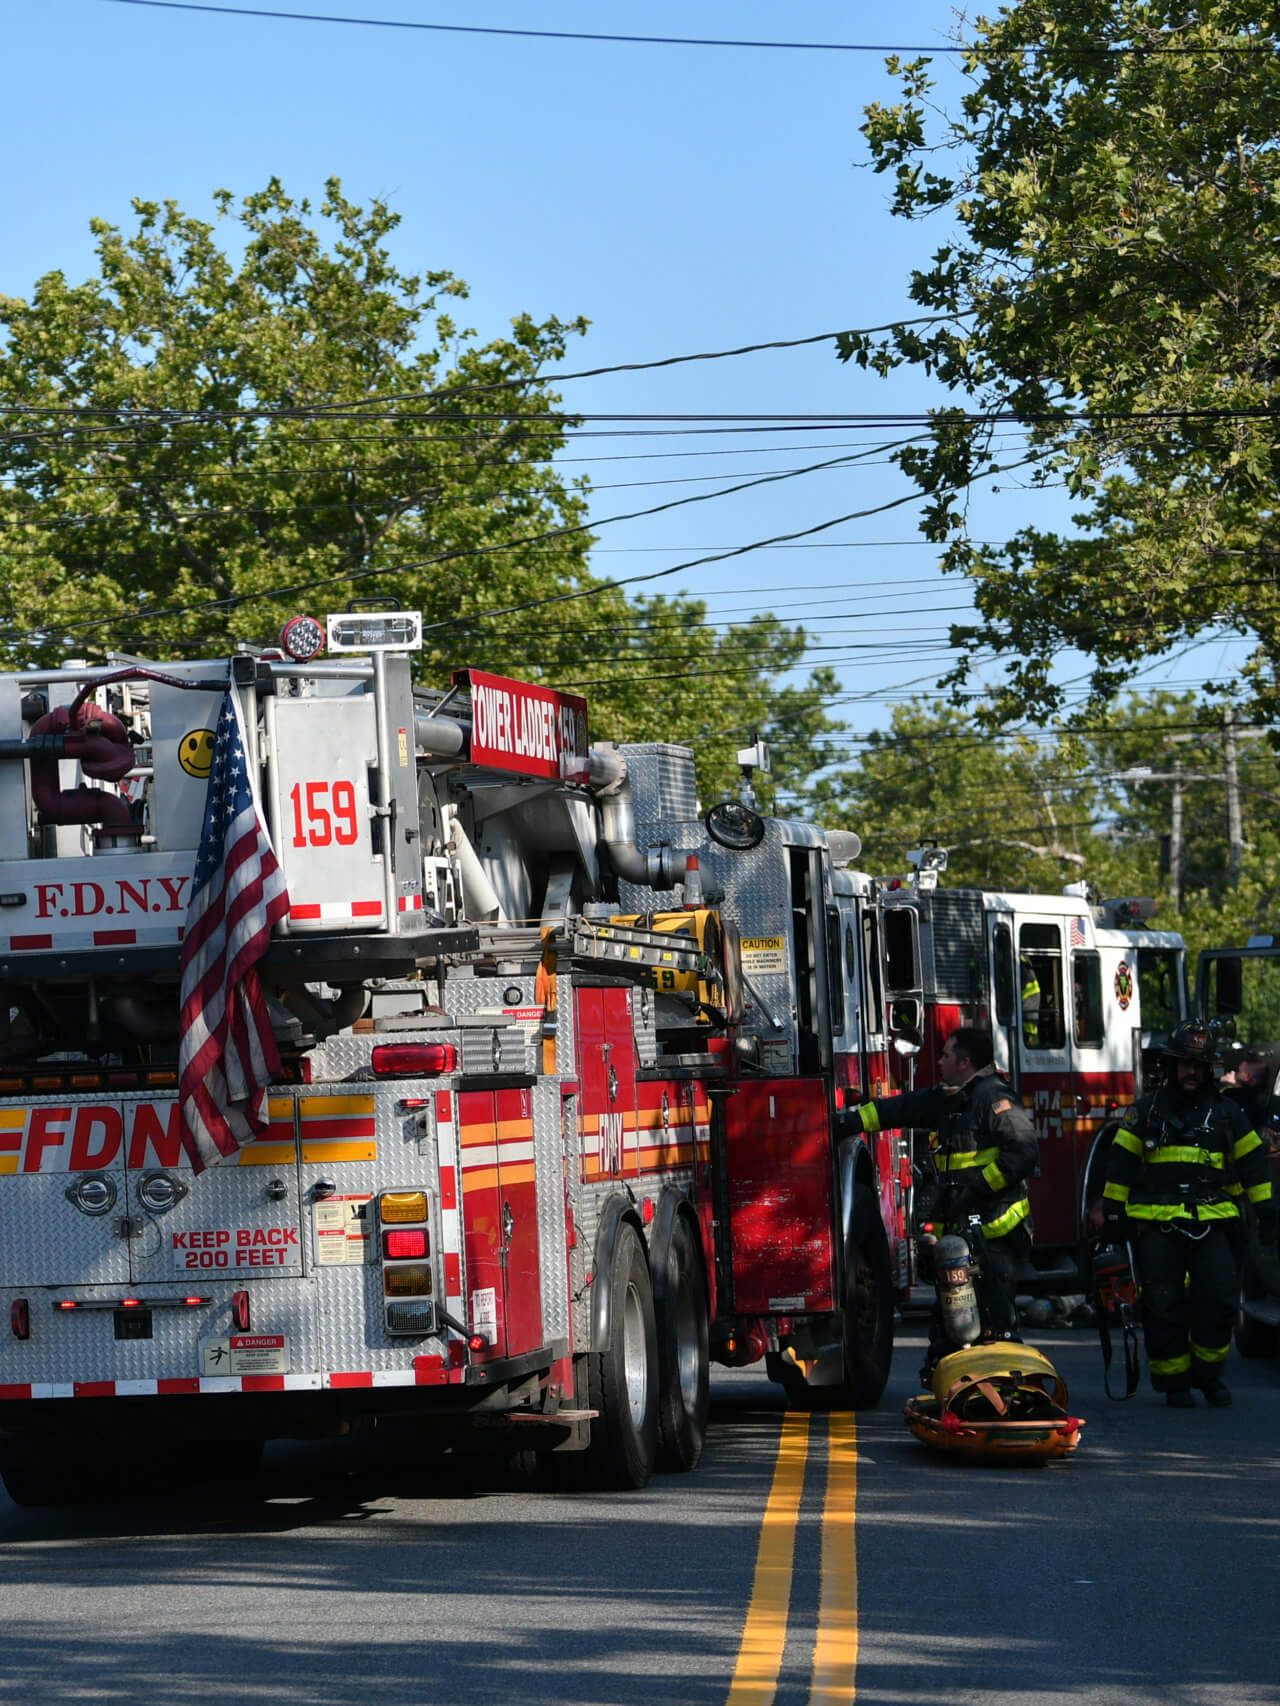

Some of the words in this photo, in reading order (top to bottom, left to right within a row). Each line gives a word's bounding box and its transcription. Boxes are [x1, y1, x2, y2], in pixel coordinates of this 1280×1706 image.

[471, 684, 513, 753] TOWER
[513, 694, 558, 762] LADDER
[558, 704, 576, 758] 159
[290, 780, 358, 848] 159
[34, 876, 190, 918] F.D.N.Y
[742, 938, 780, 949] CAUTION
[23, 1102, 184, 1173] FDN
[599, 1112, 623, 1173] FDNY
[172, 1230, 230, 1249] KEEP
[236, 1227, 298, 1247] BACK
[185, 1250, 229, 1269] 200
[235, 1248, 288, 1266] FEET
[945, 1269, 965, 1281] 159
[245, 1338, 277, 1346] DANGER
